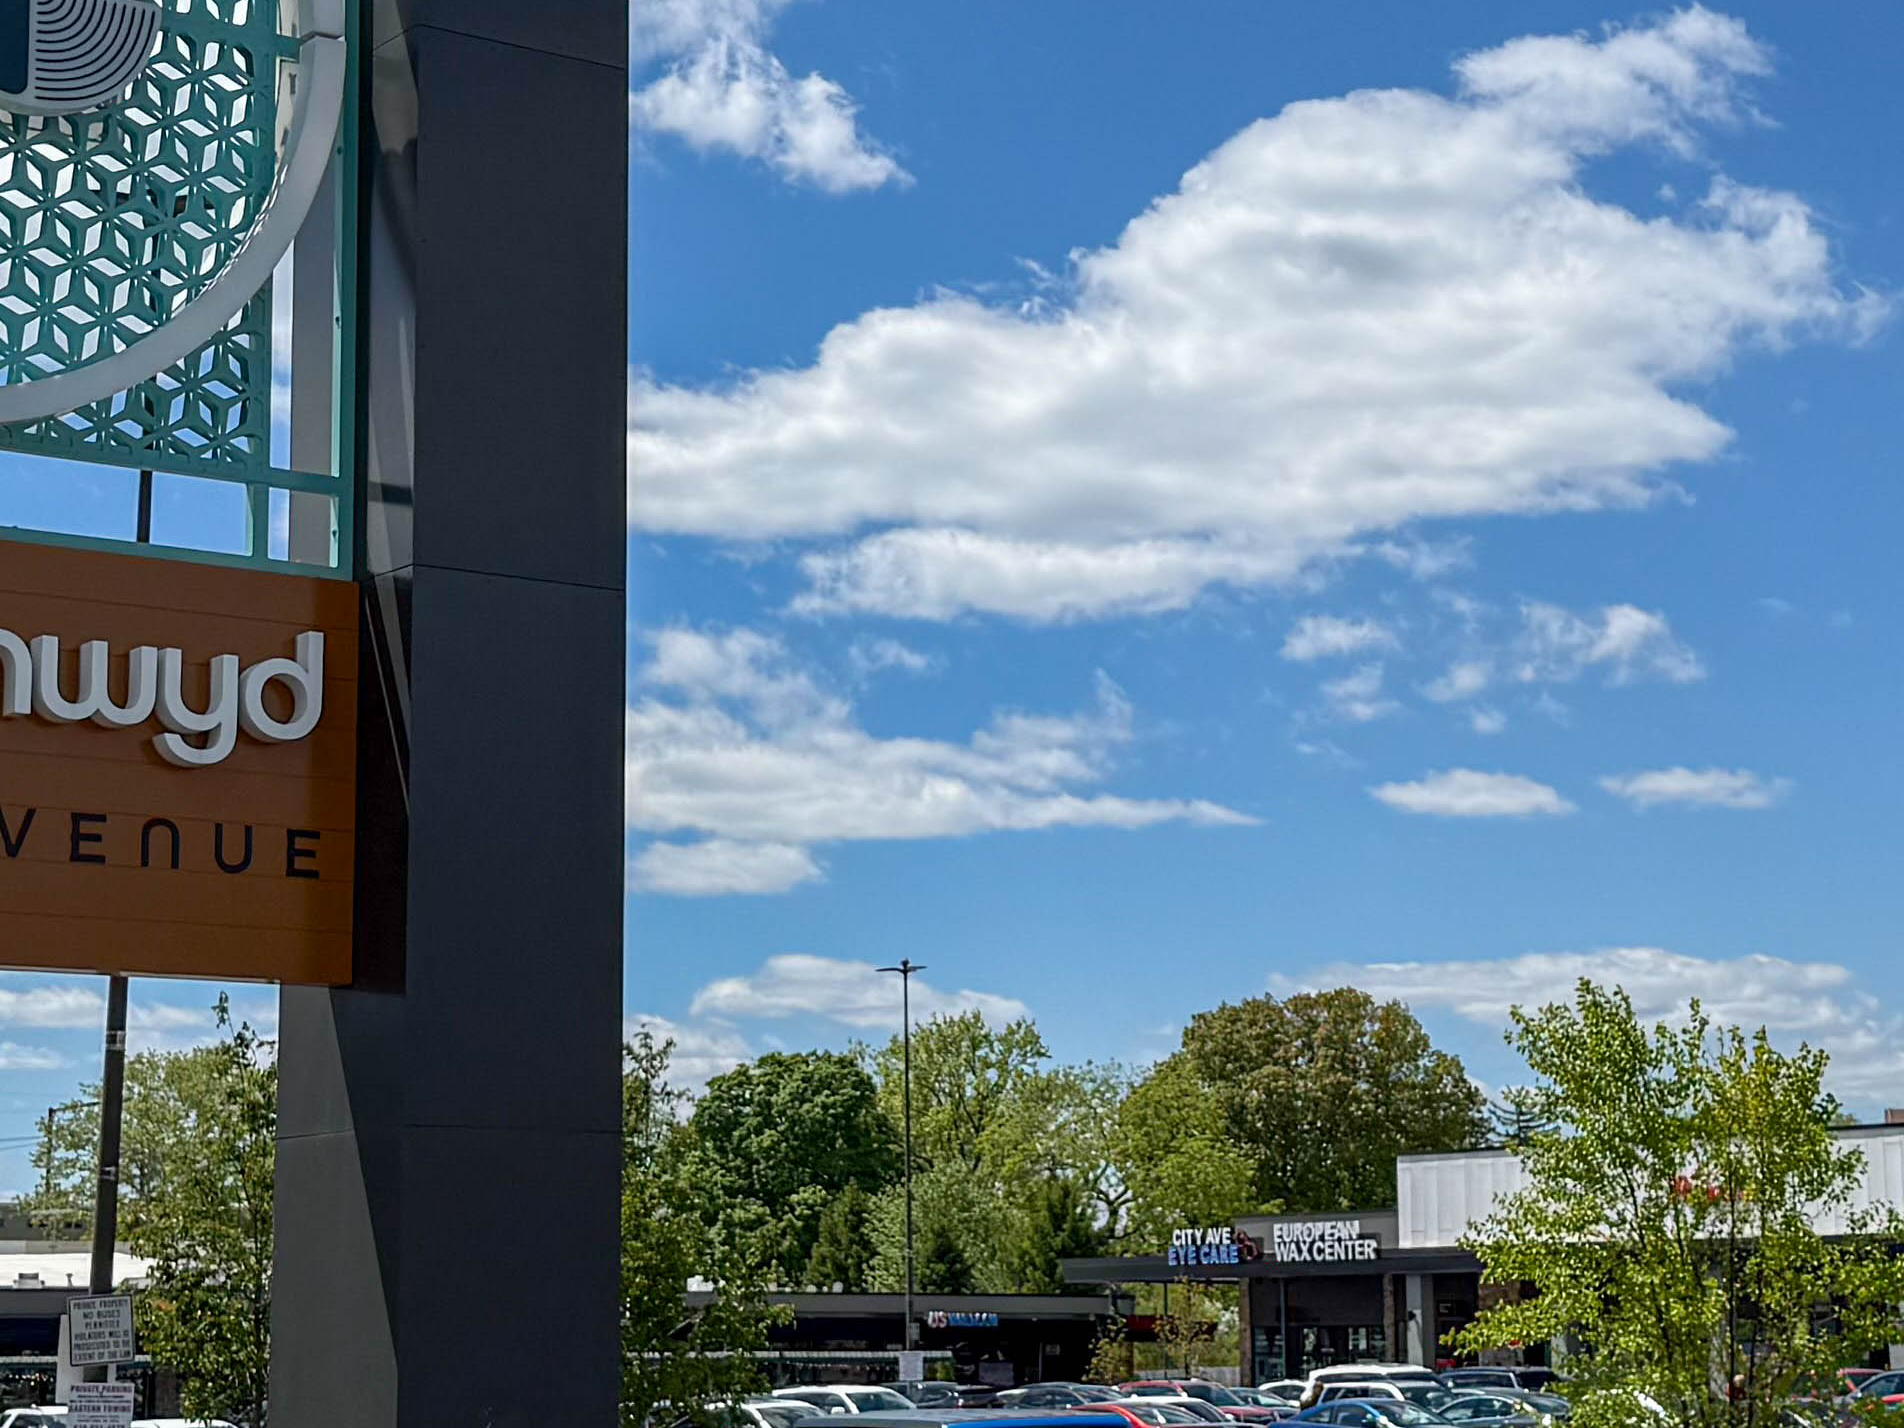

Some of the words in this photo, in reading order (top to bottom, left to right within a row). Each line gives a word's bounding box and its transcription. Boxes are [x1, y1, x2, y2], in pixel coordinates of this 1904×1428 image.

[1172, 1227, 1203, 1246] CITY
[1205, 1226, 1232, 1245] AVE
[1273, 1220, 1361, 1242] EUROPEAN
[1168, 1246, 1197, 1266] EYE
[1199, 1243, 1239, 1265] CARE
[1275, 1241, 1312, 1262] WAX
[1313, 1239, 1378, 1261] CENTER
